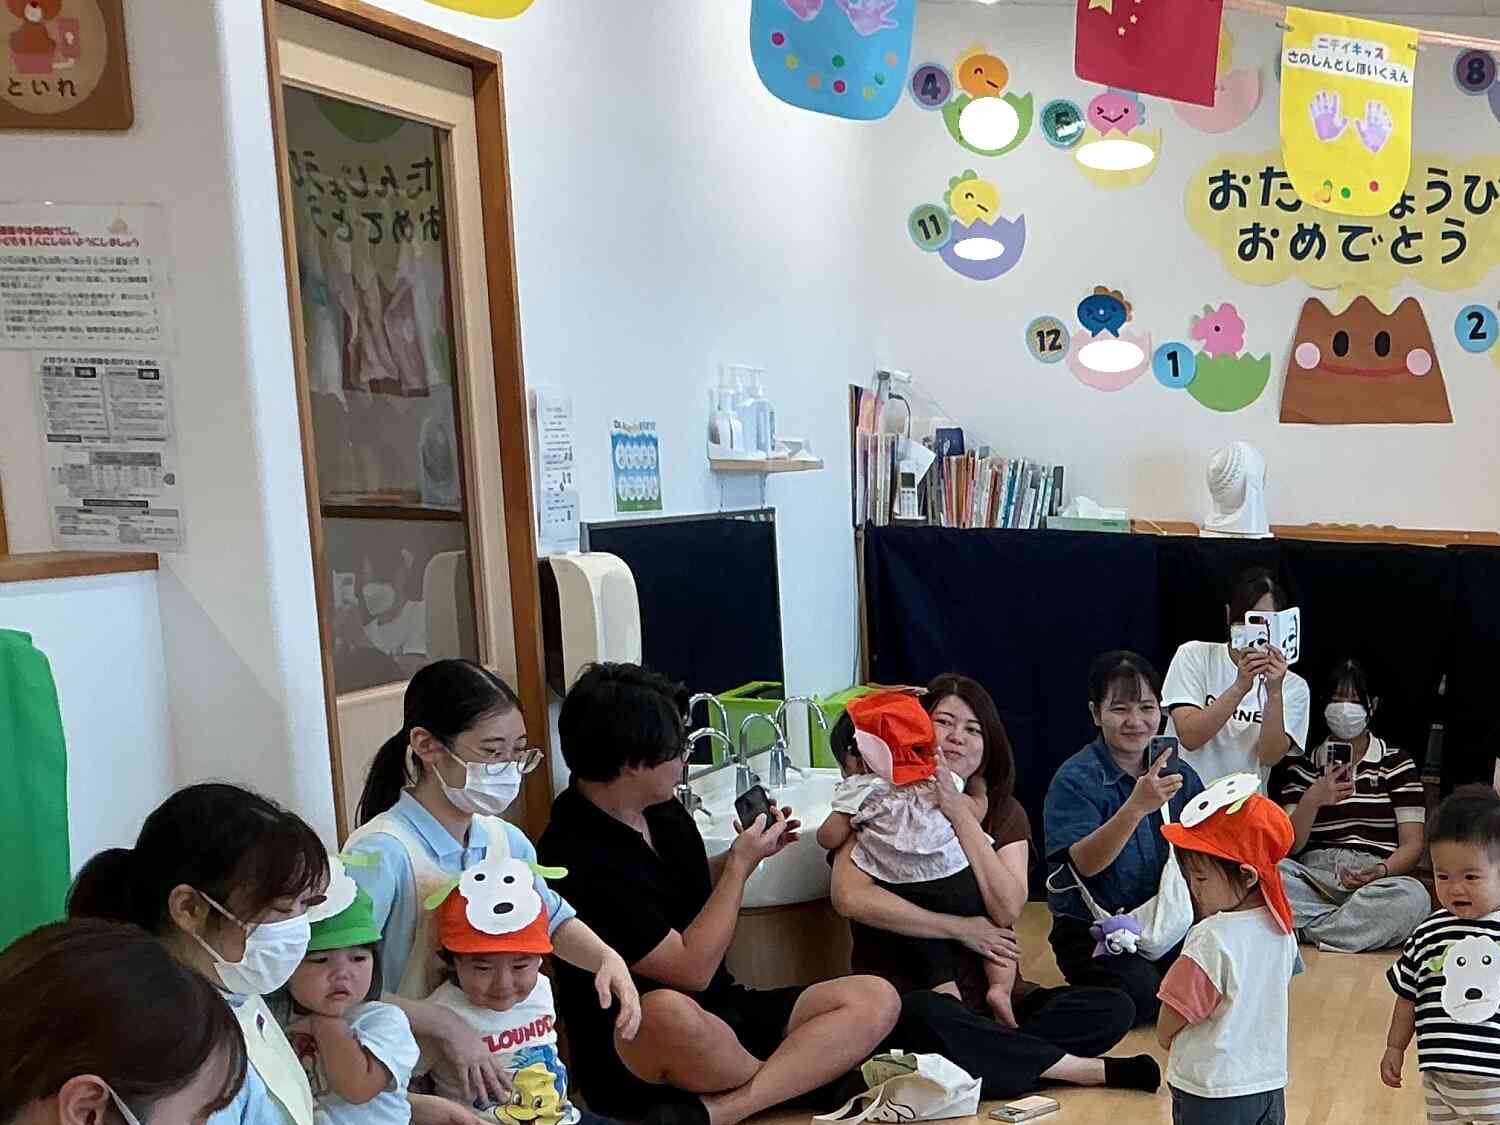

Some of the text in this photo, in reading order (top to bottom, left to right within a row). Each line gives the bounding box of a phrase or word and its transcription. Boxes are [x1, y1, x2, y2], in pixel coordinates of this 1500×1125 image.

[1465, 57, 1486, 86] 8
[7, 77, 77, 97] といれ
[921, 73, 941, 99] 4
[917, 214, 942, 241] 11
[1237, 217, 1468, 265] おめでとう
[1466, 311, 1488, 340] 2
[1035, 328, 1063, 353] 12
[1166, 350, 1181, 378] 1
